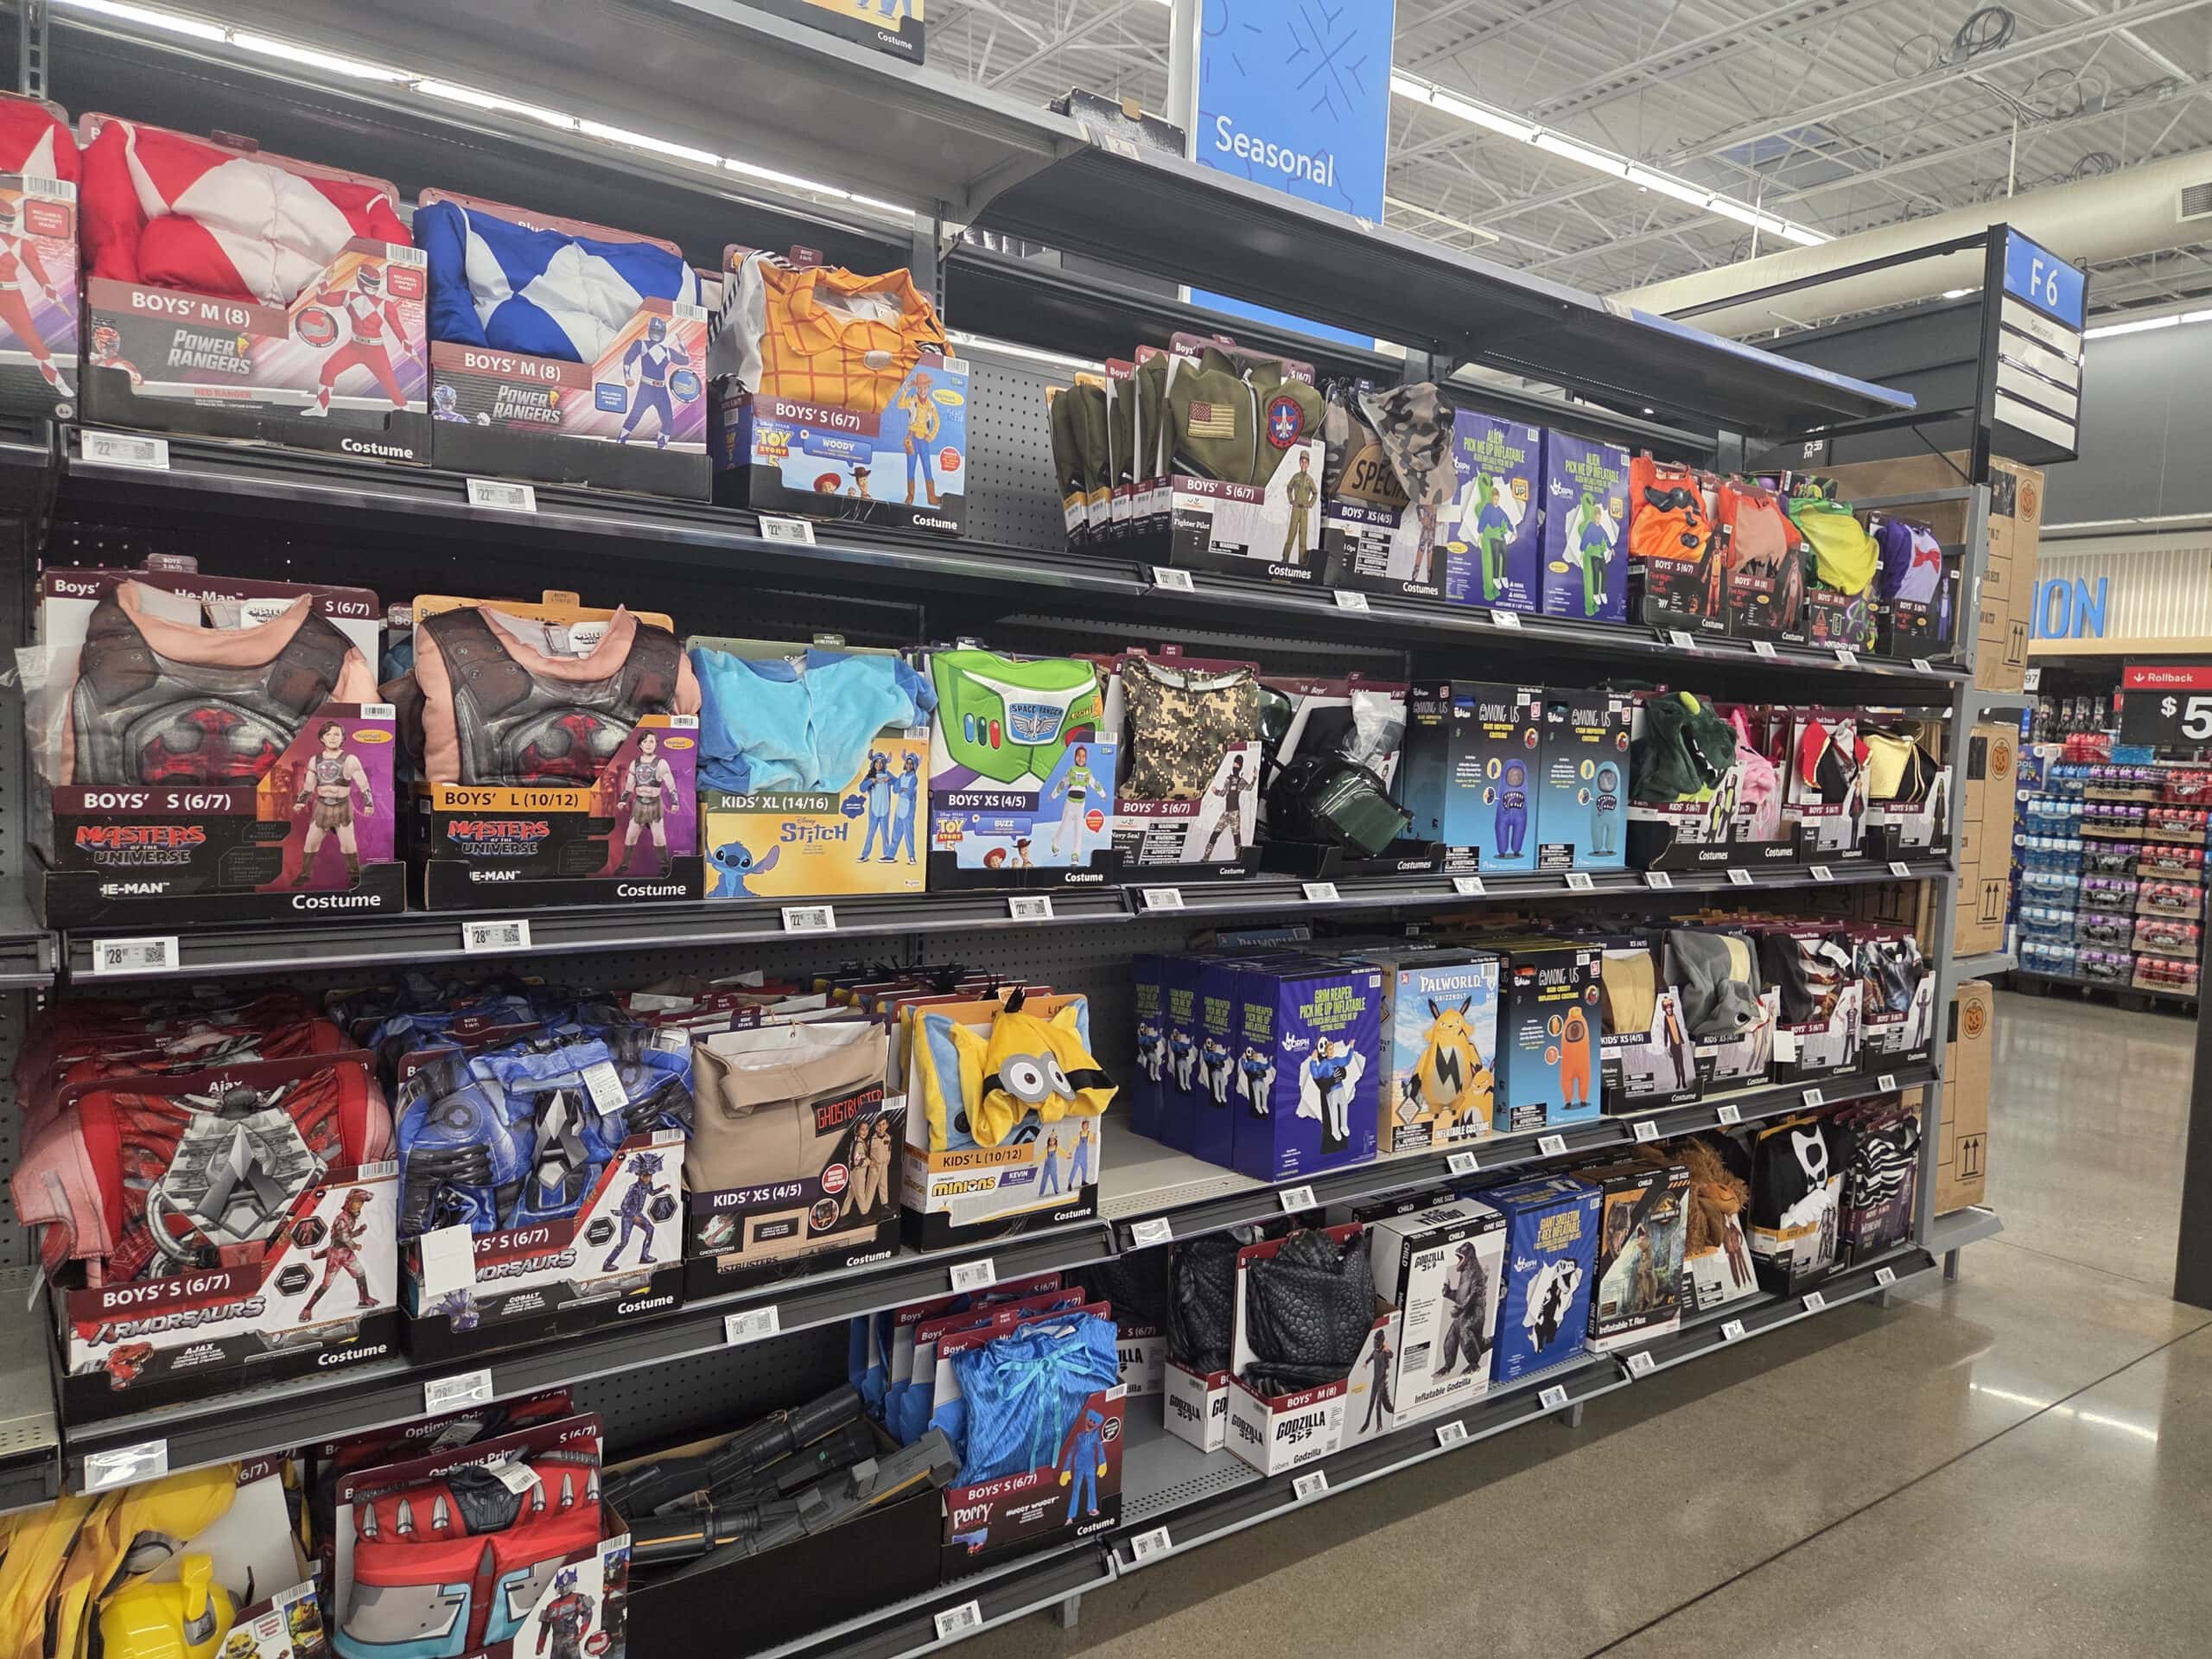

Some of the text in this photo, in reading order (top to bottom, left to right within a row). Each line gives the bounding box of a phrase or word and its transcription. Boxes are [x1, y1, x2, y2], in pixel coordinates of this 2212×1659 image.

[877, 31, 912, 50] Costume
[1215, 114, 1334, 188] Seasonal
[2030, 257, 2059, 307] F6
[131, 291, 251, 328] BOYS' M (8)
[172, 328, 238, 356] POWER
[1175, 341, 1197, 355] Boys'
[167, 347, 251, 376] RANGERS
[464, 352, 562, 382] BOYS' M (8)
[1110, 366, 1129, 379] Boys'
[497, 385, 551, 407] POWER
[492, 404, 562, 424] RANGERS
[775, 403, 861, 431] BOYS' S (6/7)
[755, 429, 795, 447] TOY
[823, 438, 855, 452] WOODY
[340, 437, 414, 460] Costume
[760, 445, 789, 456] STORY
[1187, 479, 1255, 500] BOYS' S (6/7)
[912, 513, 958, 531] Costume
[1341, 505, 1393, 524] BOYS' XS (4/5)
[1173, 518, 1211, 531] Fighter Pilot
[1268, 563, 1313, 580] Costumes
[1655, 559, 1674, 570] BOYS'
[54, 579, 371, 617] Boys' S (6/7)
[1402, 582, 1439, 596] Costumes
[1701, 619, 1725, 631] Costume
[2148, 673, 2194, 683] Rollback
[1012, 704, 1036, 715] SPACE
[1510, 705, 1521, 723] US
[1601, 710, 1612, 728] US
[84, 792, 232, 811] BOYS' S (6/7)
[444, 791, 579, 808] BOYS' L (10/12)
[722, 795, 830, 811] KIDS' XL (14/16)
[948, 794, 1027, 809] BOYS' XS (4/5)
[1122, 802, 1191, 815] BOYS' S (6/7)
[448, 820, 551, 839] MASTERS
[937, 818, 966, 834] TOY
[995, 820, 1014, 829] BUZZ
[74, 824, 207, 847] MASTERS
[461, 841, 538, 855] UNIVERSE
[1699, 850, 1728, 861] Costumes
[1764, 847, 1794, 857] Costumes
[93, 849, 192, 866] UNIVERSE
[1396, 861, 1432, 870] Costumes
[1065, 872, 1104, 882] Costume
[616, 883, 687, 897] Costume
[292, 893, 382, 910] Costume
[1420, 973, 1481, 992] PALWORLD
[1569, 967, 1580, 983] US
[1314, 985, 1353, 1002] GRIM REAPER
[1300, 996, 1367, 1020] PICK ME UP INFLATABLE
[1600, 1034, 1618, 1045] KIDS'
[1620, 1033, 1630, 1044] XS
[1671, 1092, 1697, 1103] Costume
[1434, 1120, 1491, 1141] INFLATABLE COSTUME
[943, 1148, 1023, 1168] KIDS' L (10/12)
[1008, 1170, 1029, 1180] KEVIN
[713, 1184, 803, 1208] KIDS' XS (4/5)
[931, 1176, 996, 1198] minions
[1397, 1194, 1455, 1214] CHILD ONE SIZE
[1053, 1206, 1092, 1223] Costume
[499, 1228, 550, 1249] S (6/7)
[1448, 1219, 1506, 1243] CHILD ONE SIZE
[846, 1249, 892, 1268] Costume
[1402, 1242, 1410, 1267] CHILD
[1414, 1250, 1445, 1268] GODZILLA
[103, 1274, 232, 1308] BOYS' S (6/7)
[509, 1291, 541, 1304] COBALT
[617, 1294, 675, 1315] Costume
[89, 1295, 267, 1348] ARMORSAURS
[899, 1311, 925, 1323] Boys'
[921, 1328, 946, 1341] Boys'
[1599, 1319, 1628, 1335] Inflatable
[185, 1342, 216, 1355] AJAX
[317, 1343, 388, 1367] Costume
[943, 1344, 968, 1356] Boys'
[1287, 1385, 1337, 1408] BOYS' M (8)
[1414, 1378, 1471, 1404] Inflatable Godzilla
[1275, 1410, 1326, 1441] GODZILLA
[559, 1431, 568, 1444] S
[1293, 1446, 1322, 1465] Godzilla
[968, 1474, 1038, 1501] BOYS' S (6/7)
[953, 1503, 994, 1528] POPPY
[1077, 1517, 1116, 1536] Costume
